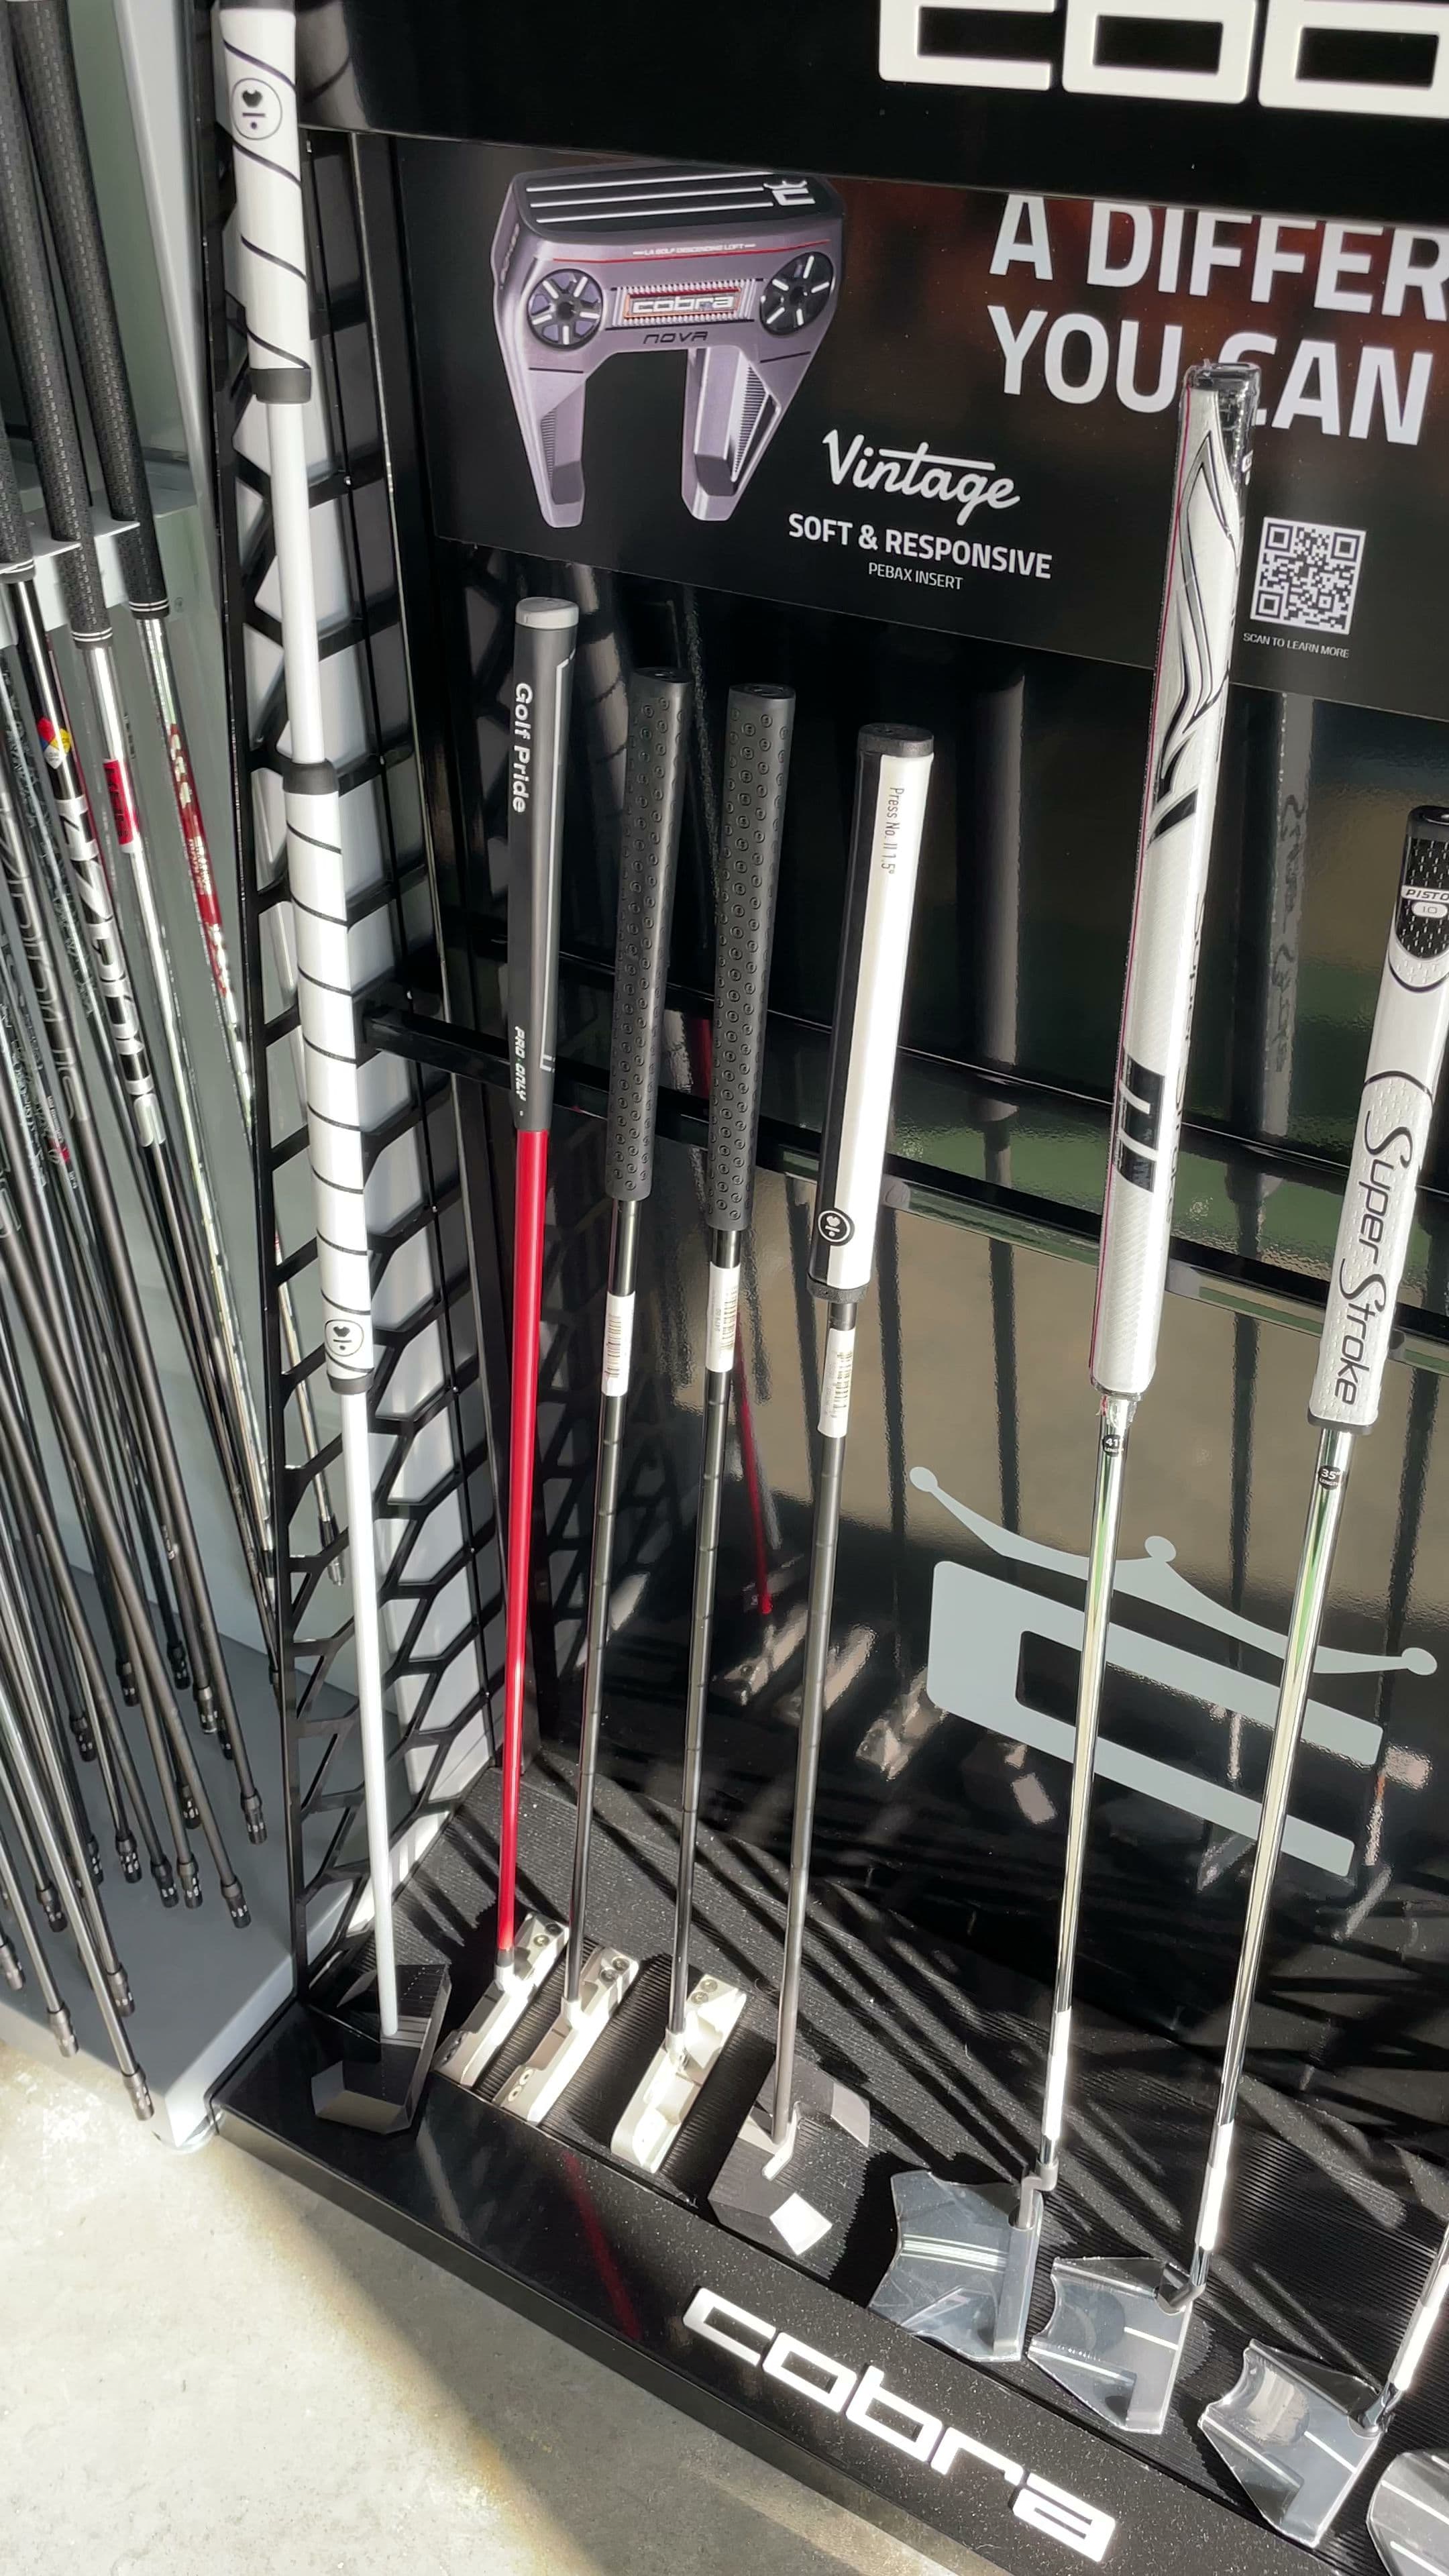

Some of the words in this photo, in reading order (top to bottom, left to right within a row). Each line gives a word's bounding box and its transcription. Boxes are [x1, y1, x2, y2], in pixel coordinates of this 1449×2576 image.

[989, 193, 1053, 281] A
[987, 305, 1183, 414] YOU
[822, 429, 1020, 526] Vintage
[788, 512, 853, 546] SOFT
[858, 524, 878, 551] &
[885, 528, 1053, 580] RESPONSIVE
[868, 561, 912, 583] PEBAX
[915, 571, 964, 590] INSERT
[1243, 632, 1271, 646] SCAN
[1271, 637, 1285, 647] TO
[1287, 639, 1319, 655] LEARN
[1320, 645, 1350, 659] MORE
[514, 682, 533, 740] Golf
[512, 745, 531, 814] Pride
[887, 786, 905, 819] Press
[884, 822, 901, 839] No.
[514, 1026, 527, 1059] PRO
[515, 1063, 527, 1102] ONLY
[1356, 1110, 1413, 1265] Super
[1334, 1257, 1387, 1406] Stroke
[682, 2286, 1116, 2563] cobra
